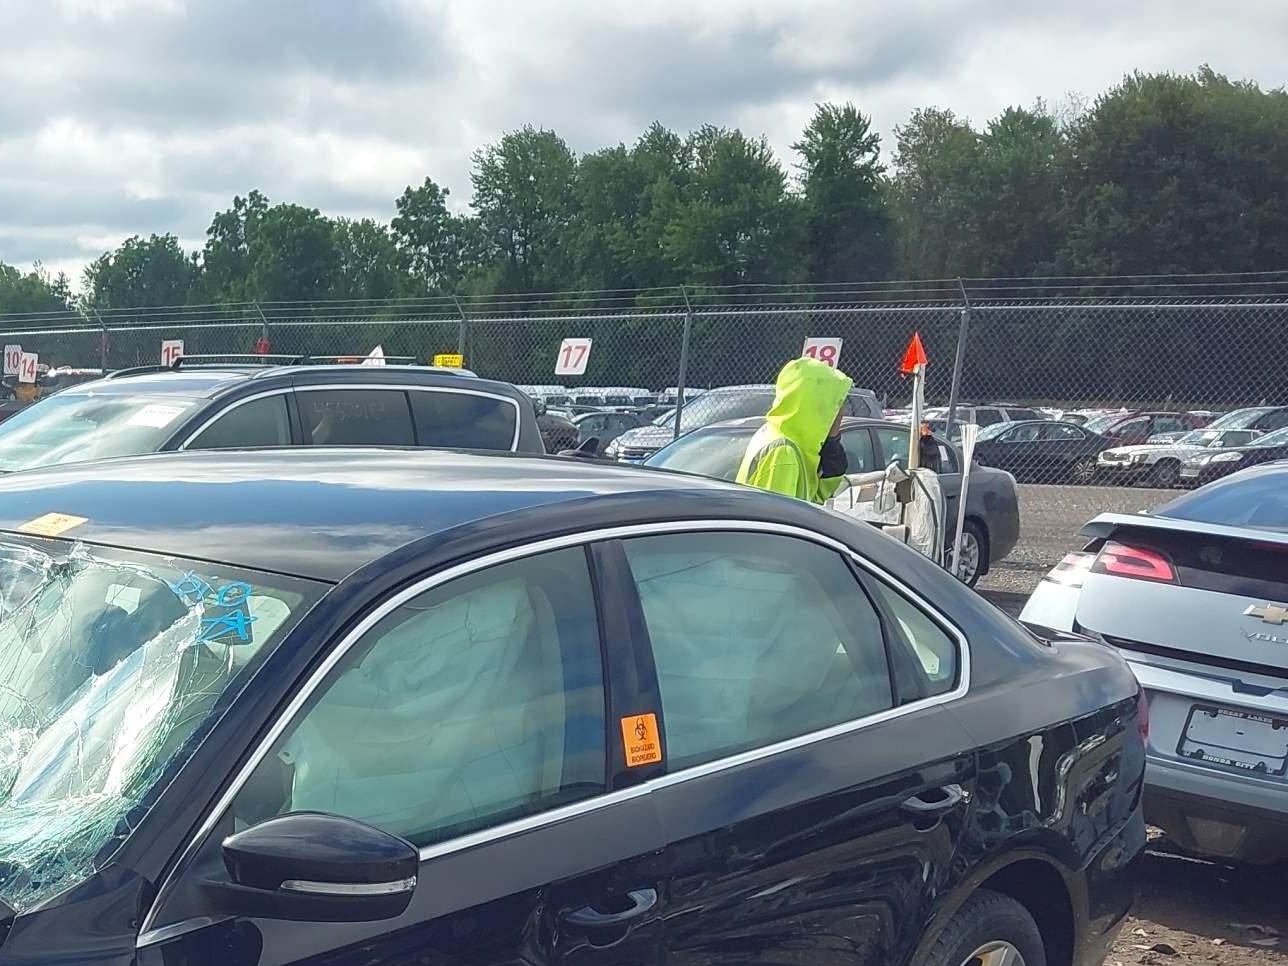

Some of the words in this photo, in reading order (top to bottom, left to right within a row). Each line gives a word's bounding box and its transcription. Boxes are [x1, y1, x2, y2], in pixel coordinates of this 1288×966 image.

[562, 344, 588, 368] 17
[806, 345, 837, 368] 18
[21, 359, 35, 378] 14
[1202, 754, 1232, 765] HONDA
